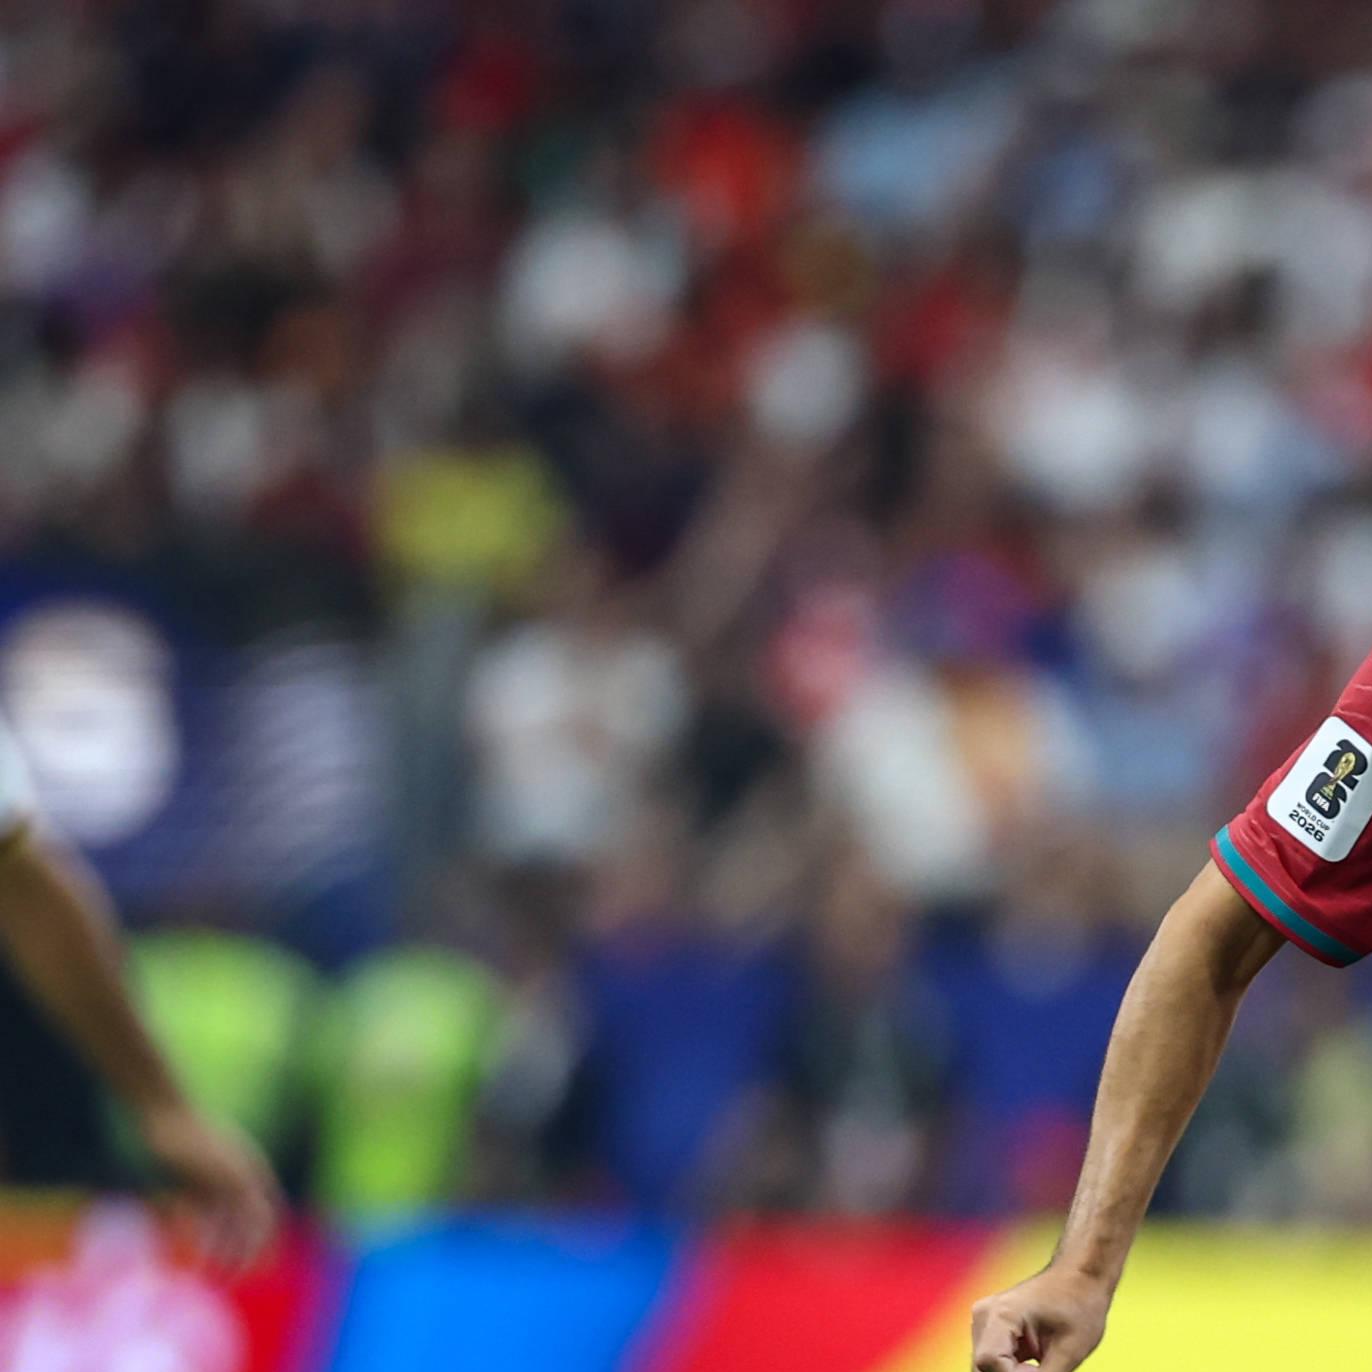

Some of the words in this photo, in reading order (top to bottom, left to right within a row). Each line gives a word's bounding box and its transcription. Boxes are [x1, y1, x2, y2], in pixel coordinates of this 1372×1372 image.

[1297, 802, 1317, 822] WORLD
[1316, 819, 1330, 831] CUP
[1312, 792, 1330, 812] FIFA
[1288, 809, 1325, 842] 2026
